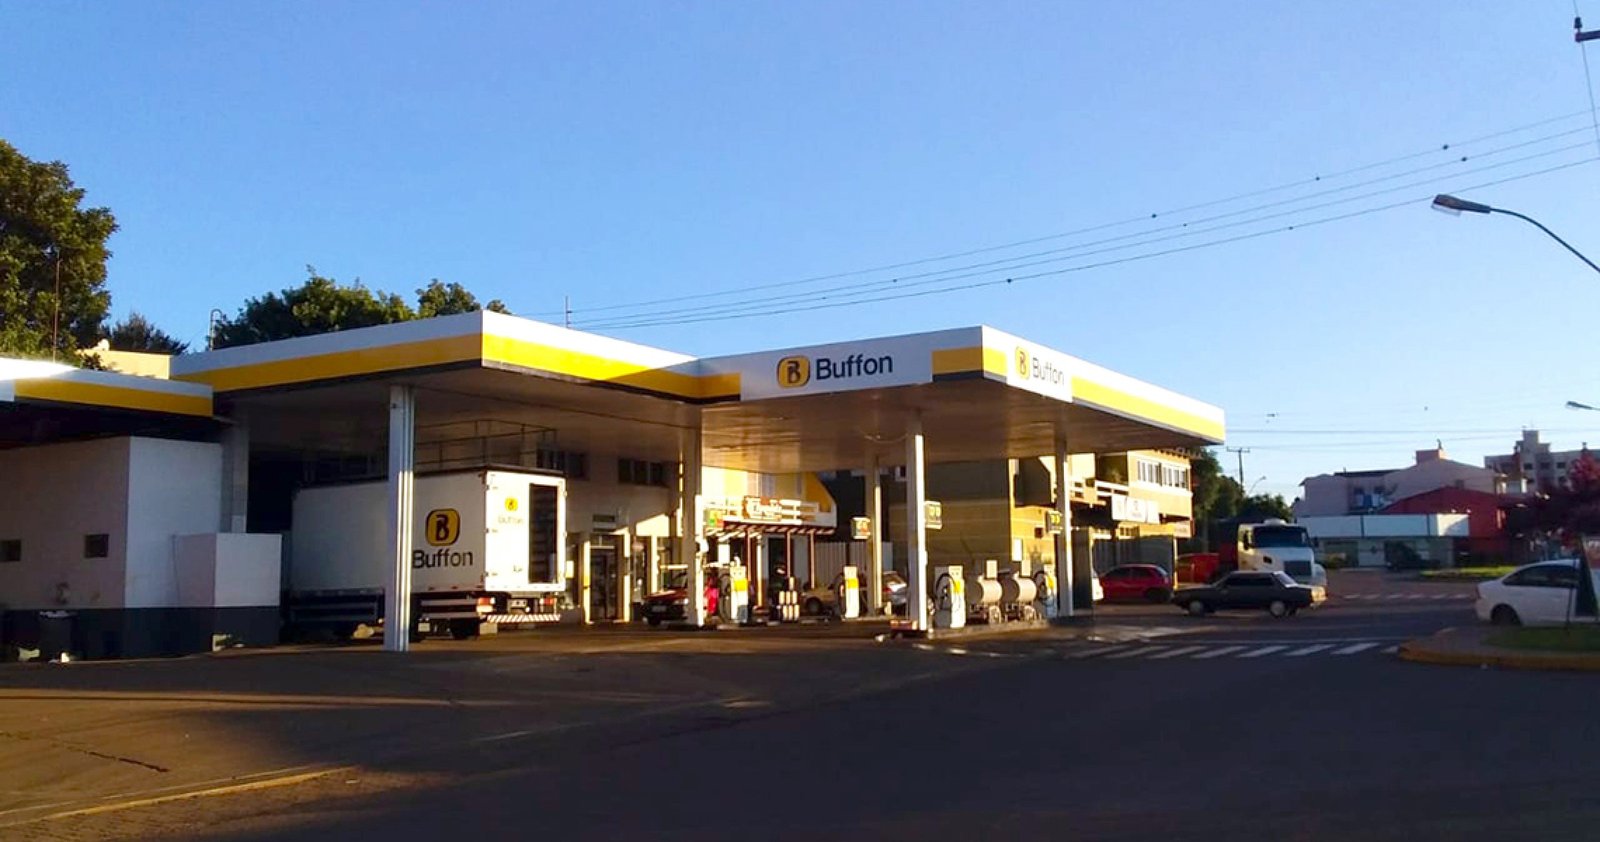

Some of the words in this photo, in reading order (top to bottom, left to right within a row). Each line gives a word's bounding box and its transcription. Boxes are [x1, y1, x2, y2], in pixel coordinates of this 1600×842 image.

[816, 353, 893, 381] Buffon
[1032, 357, 1065, 386] Buffon
[413, 548, 473, 569] Buffon
